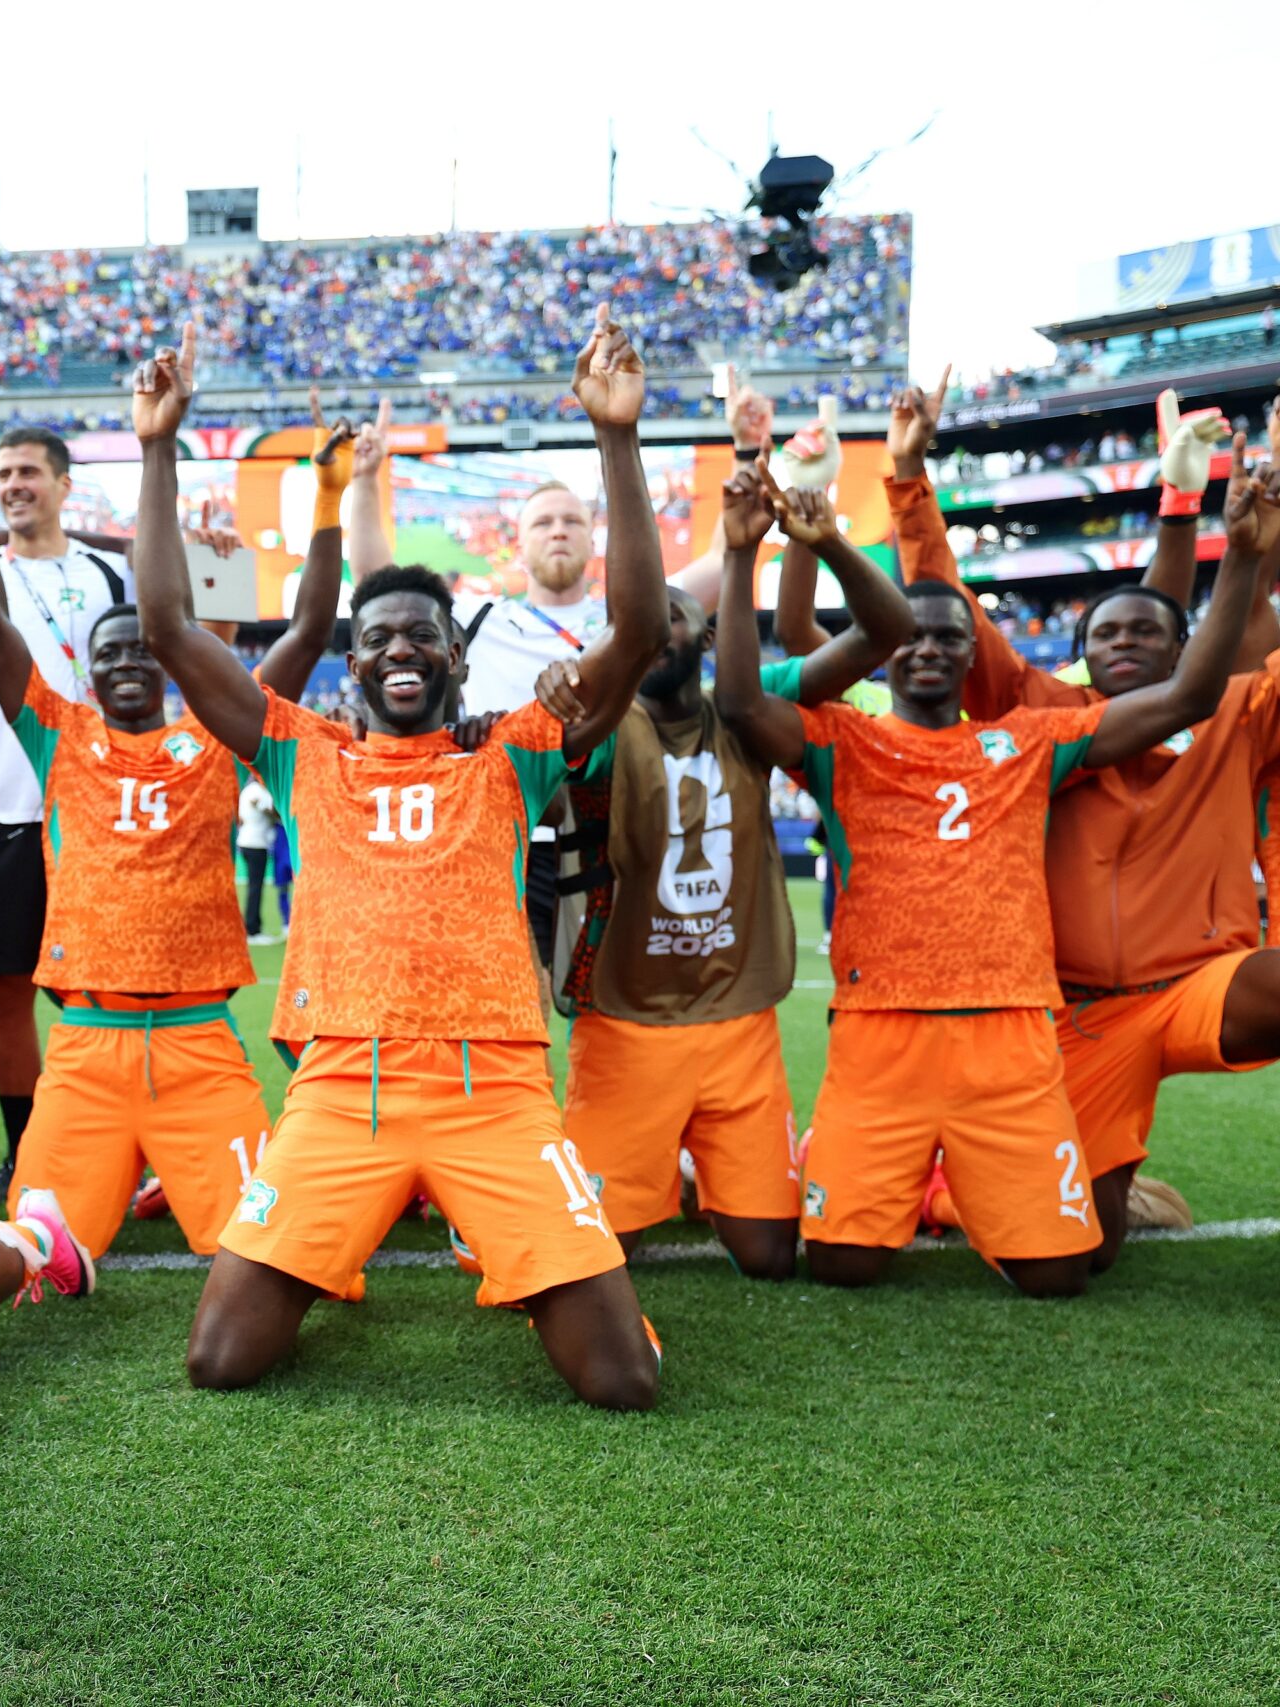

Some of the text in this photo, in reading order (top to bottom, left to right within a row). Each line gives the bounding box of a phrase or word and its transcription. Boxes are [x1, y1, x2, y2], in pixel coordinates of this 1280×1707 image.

[113, 777, 171, 831] 14
[367, 783, 436, 843] 18
[934, 781, 971, 841] 2
[674, 878, 722, 898] FIFA
[646, 923, 737, 957] 2026
[651, 915, 714, 935] WORLD
[1054, 1140, 1085, 1203] 2
